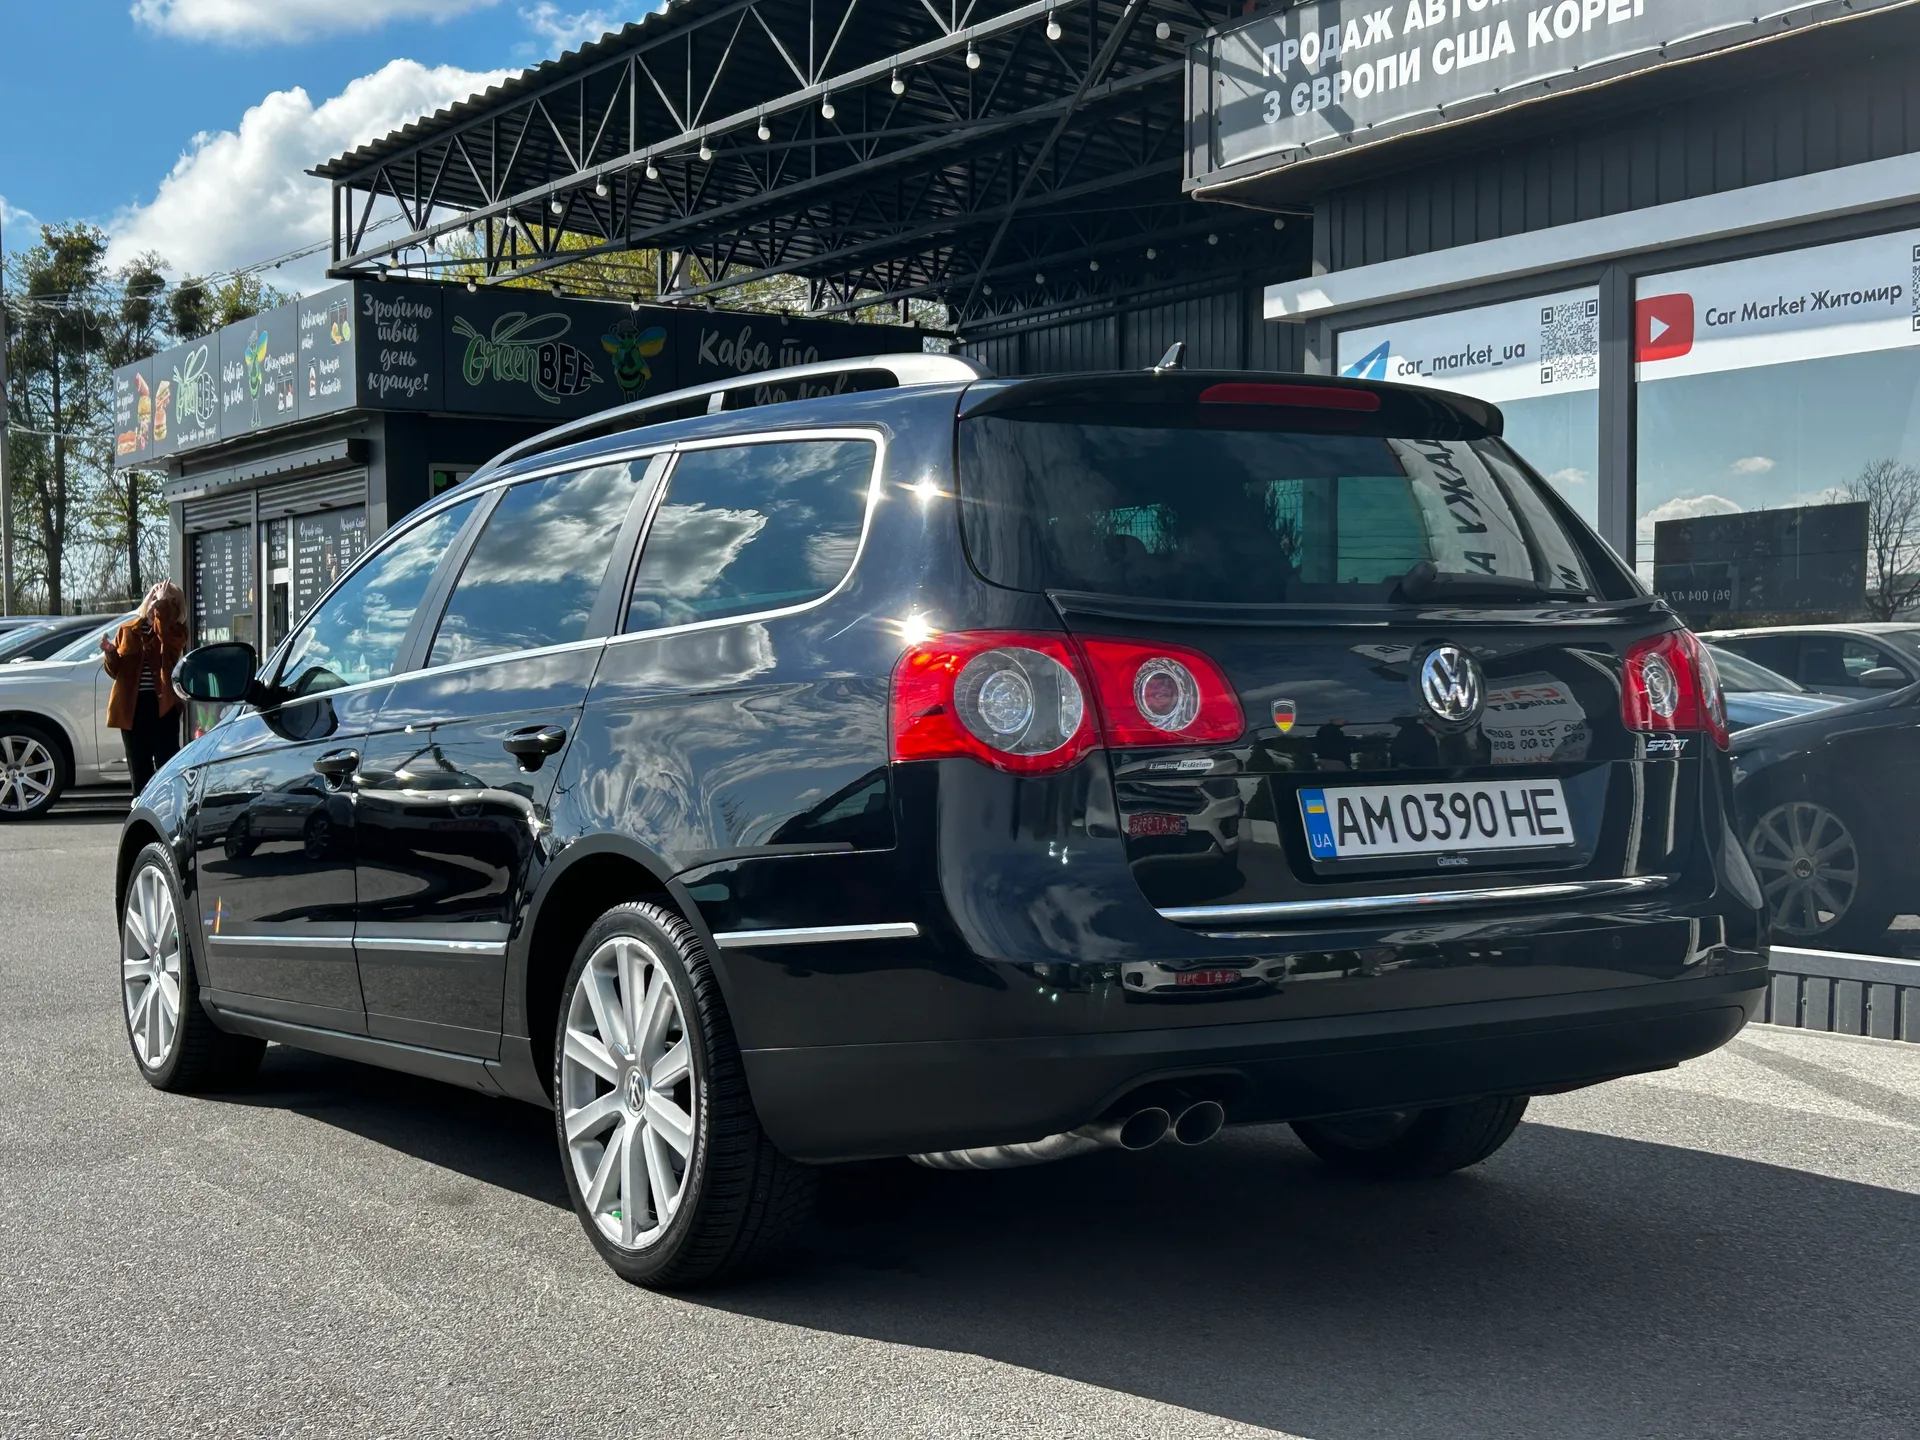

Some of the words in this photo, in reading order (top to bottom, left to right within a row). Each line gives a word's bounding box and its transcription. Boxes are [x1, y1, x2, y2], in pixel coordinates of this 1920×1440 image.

[1262, 6, 1394, 77] ПРОДАЖ
[1263, 90, 1281, 124] З
[1290, 47, 1421, 117] ЄВРОПИ
[1432, 20, 1516, 75] США
[362, 293, 434, 325] Зробимо
[1705, 307, 1737, 327] Car
[1741, 296, 1807, 322] Market
[1810, 284, 1903, 312] Житомир
[377, 318, 419, 343] твій
[380, 348, 417, 372] день
[698, 325, 774, 373] Кава
[1397, 343, 1526, 378] car_market_ua
[367, 372, 429, 399] краще!
[1645, 738, 1690, 752] SPORT
[1312, 832, 1333, 849] UA
